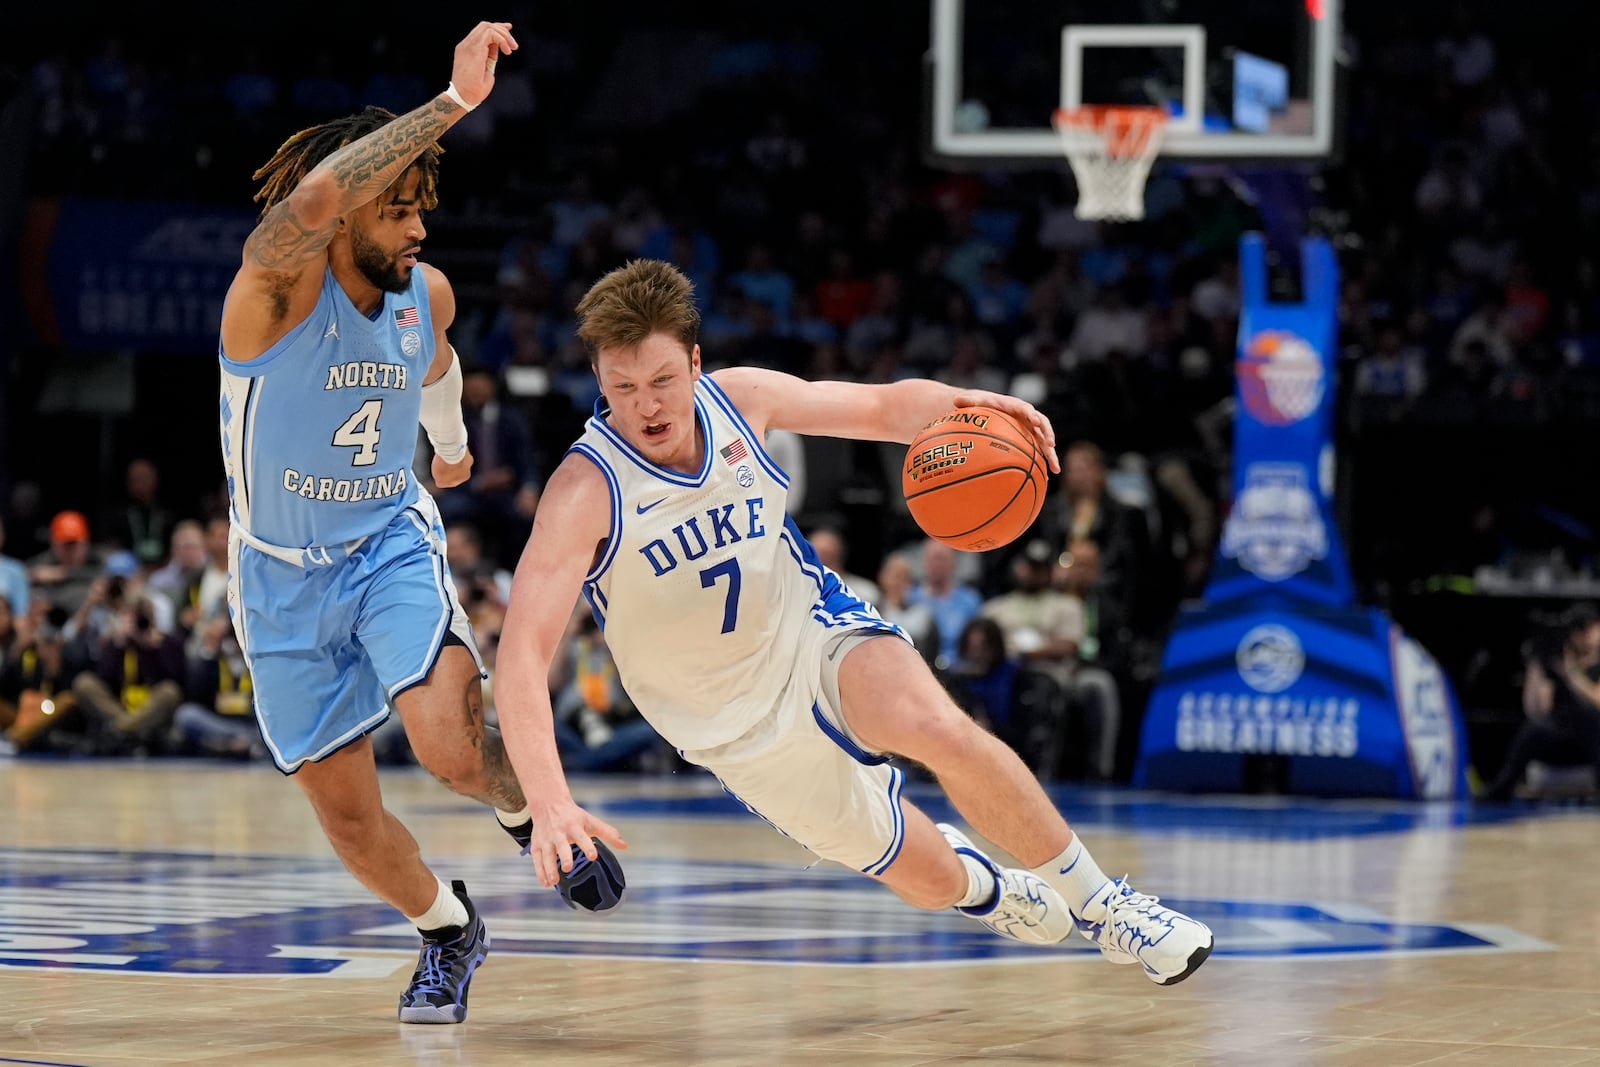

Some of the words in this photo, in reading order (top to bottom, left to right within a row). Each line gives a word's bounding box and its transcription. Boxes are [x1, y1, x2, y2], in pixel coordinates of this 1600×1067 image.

[324, 361, 407, 390] NORTH
[331, 399, 383, 466] 4
[906, 441, 974, 474] LEGACY
[283, 468, 407, 502] CAROLINA
[638, 497, 765, 577] DUKE
[699, 557, 741, 634] 7
[1175, 719, 1358, 758] GREATNESS
